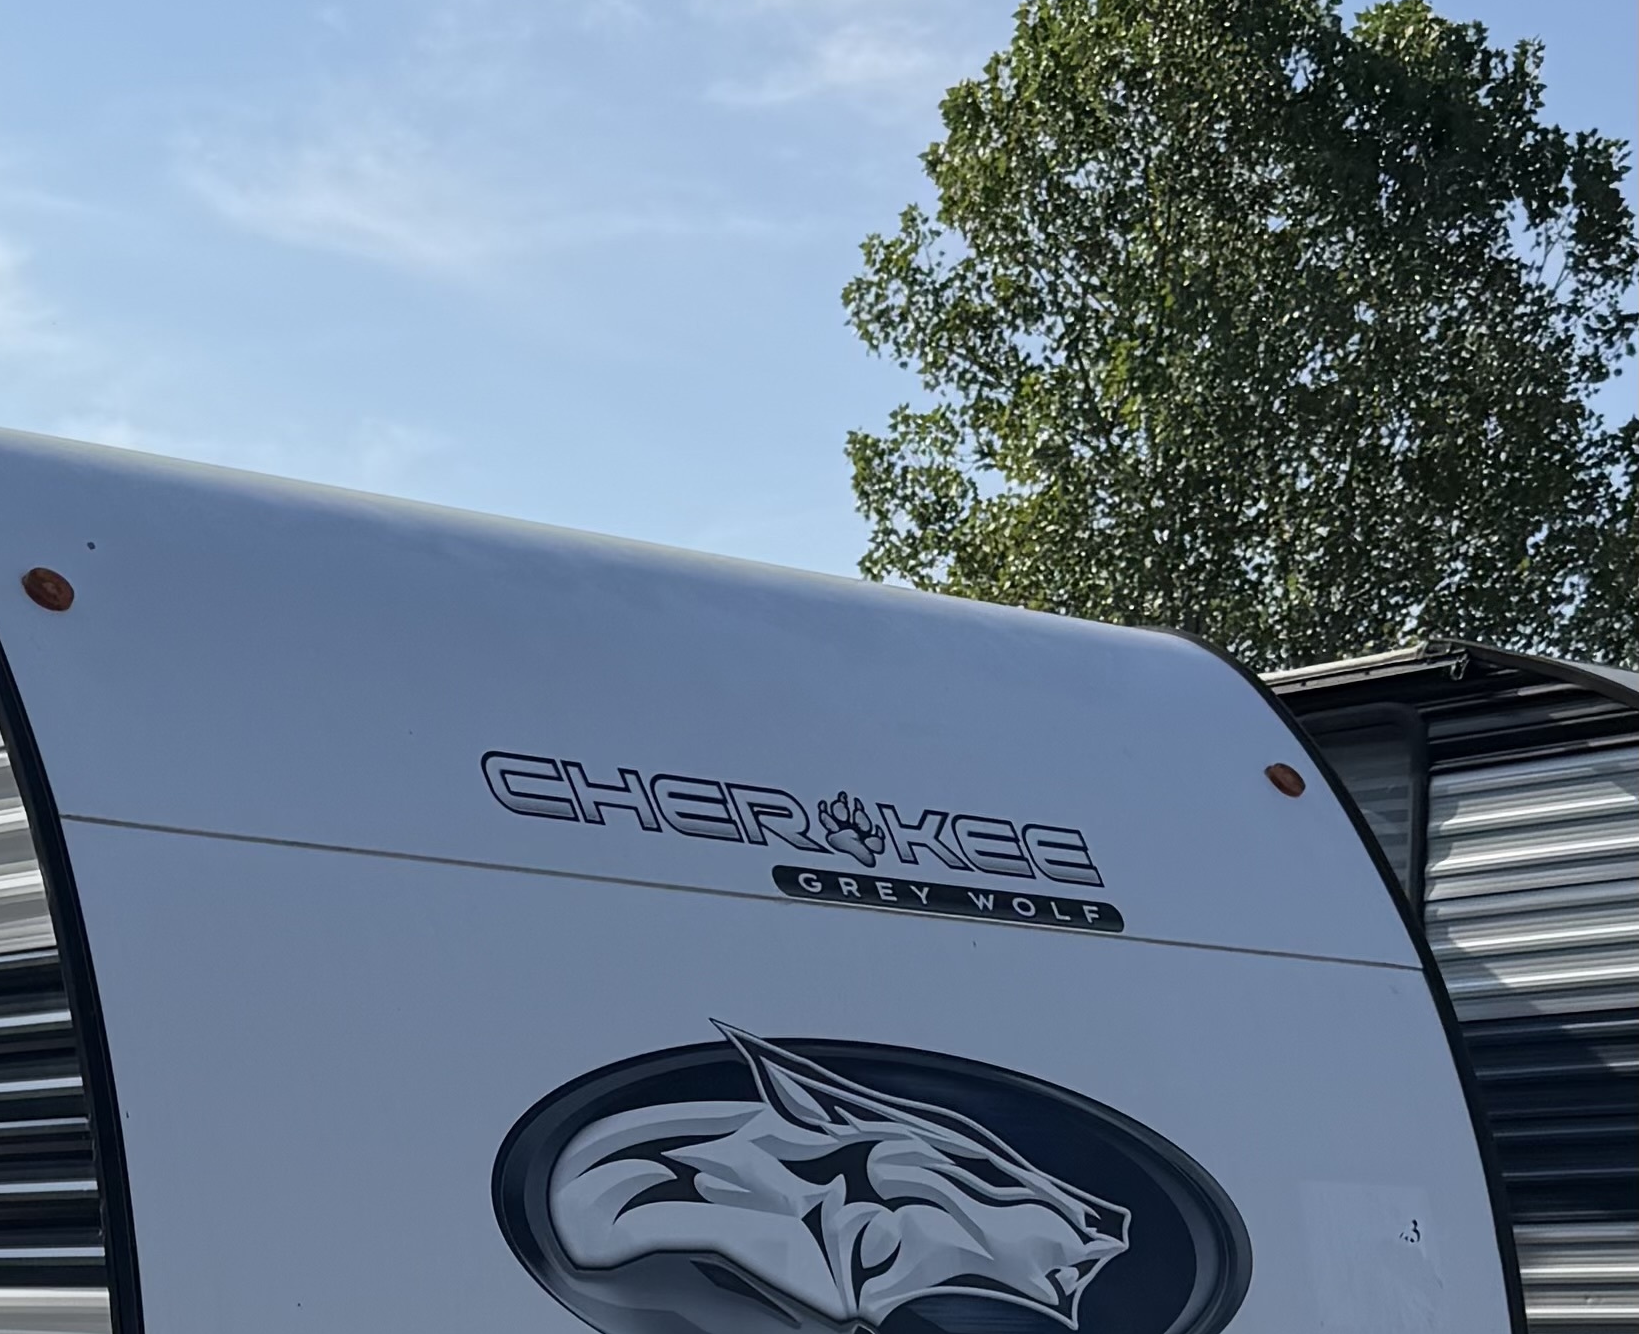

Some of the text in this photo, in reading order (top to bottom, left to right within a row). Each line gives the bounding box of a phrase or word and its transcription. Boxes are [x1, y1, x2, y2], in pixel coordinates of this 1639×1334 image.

[481, 750, 1105, 888] CHERKEE
[798, 871, 1103, 924] GREY WOLF
